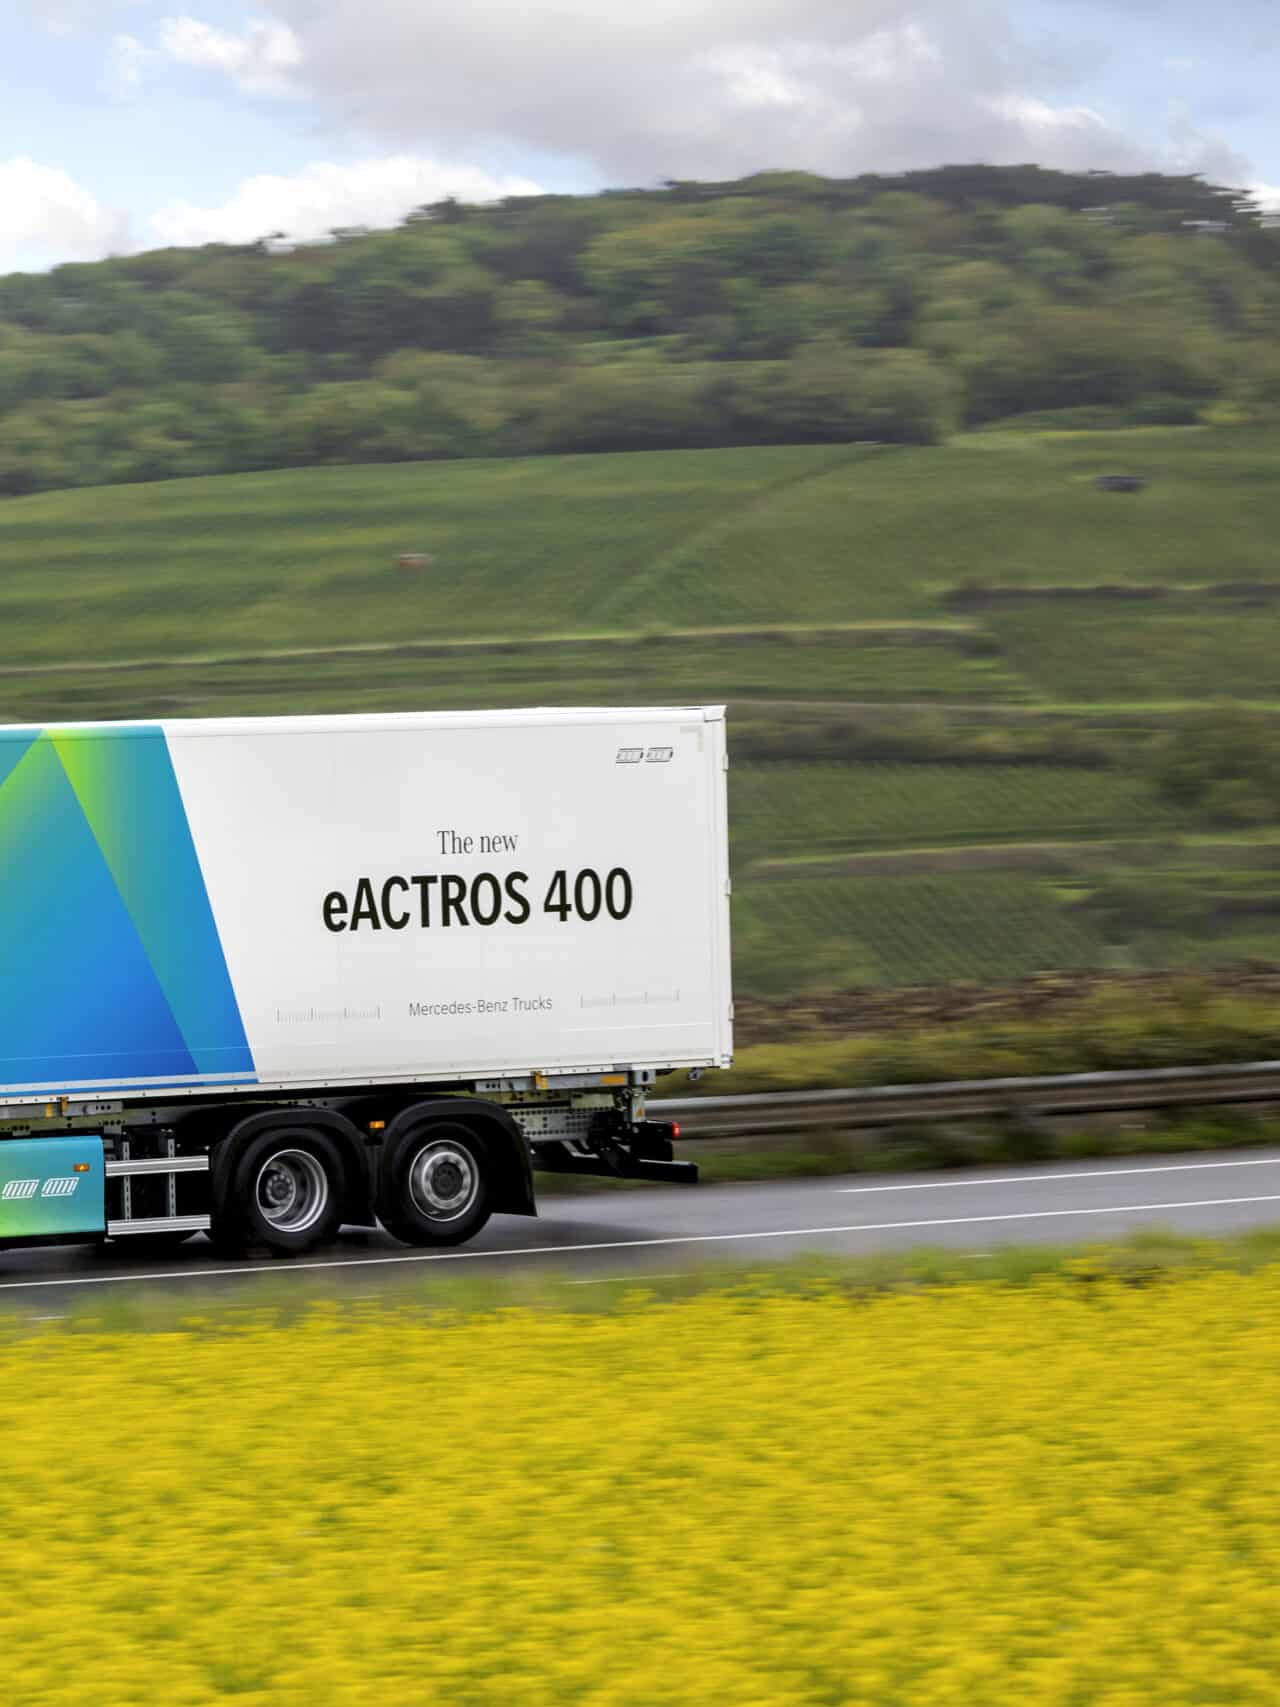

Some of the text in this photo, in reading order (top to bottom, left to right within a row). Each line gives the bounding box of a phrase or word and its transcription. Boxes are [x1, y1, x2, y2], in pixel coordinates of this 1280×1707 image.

[436, 829, 519, 855] The new
[322, 867, 633, 932] eACTROS 400
[408, 996, 553, 1017] Mercedes-Benz Trucks
